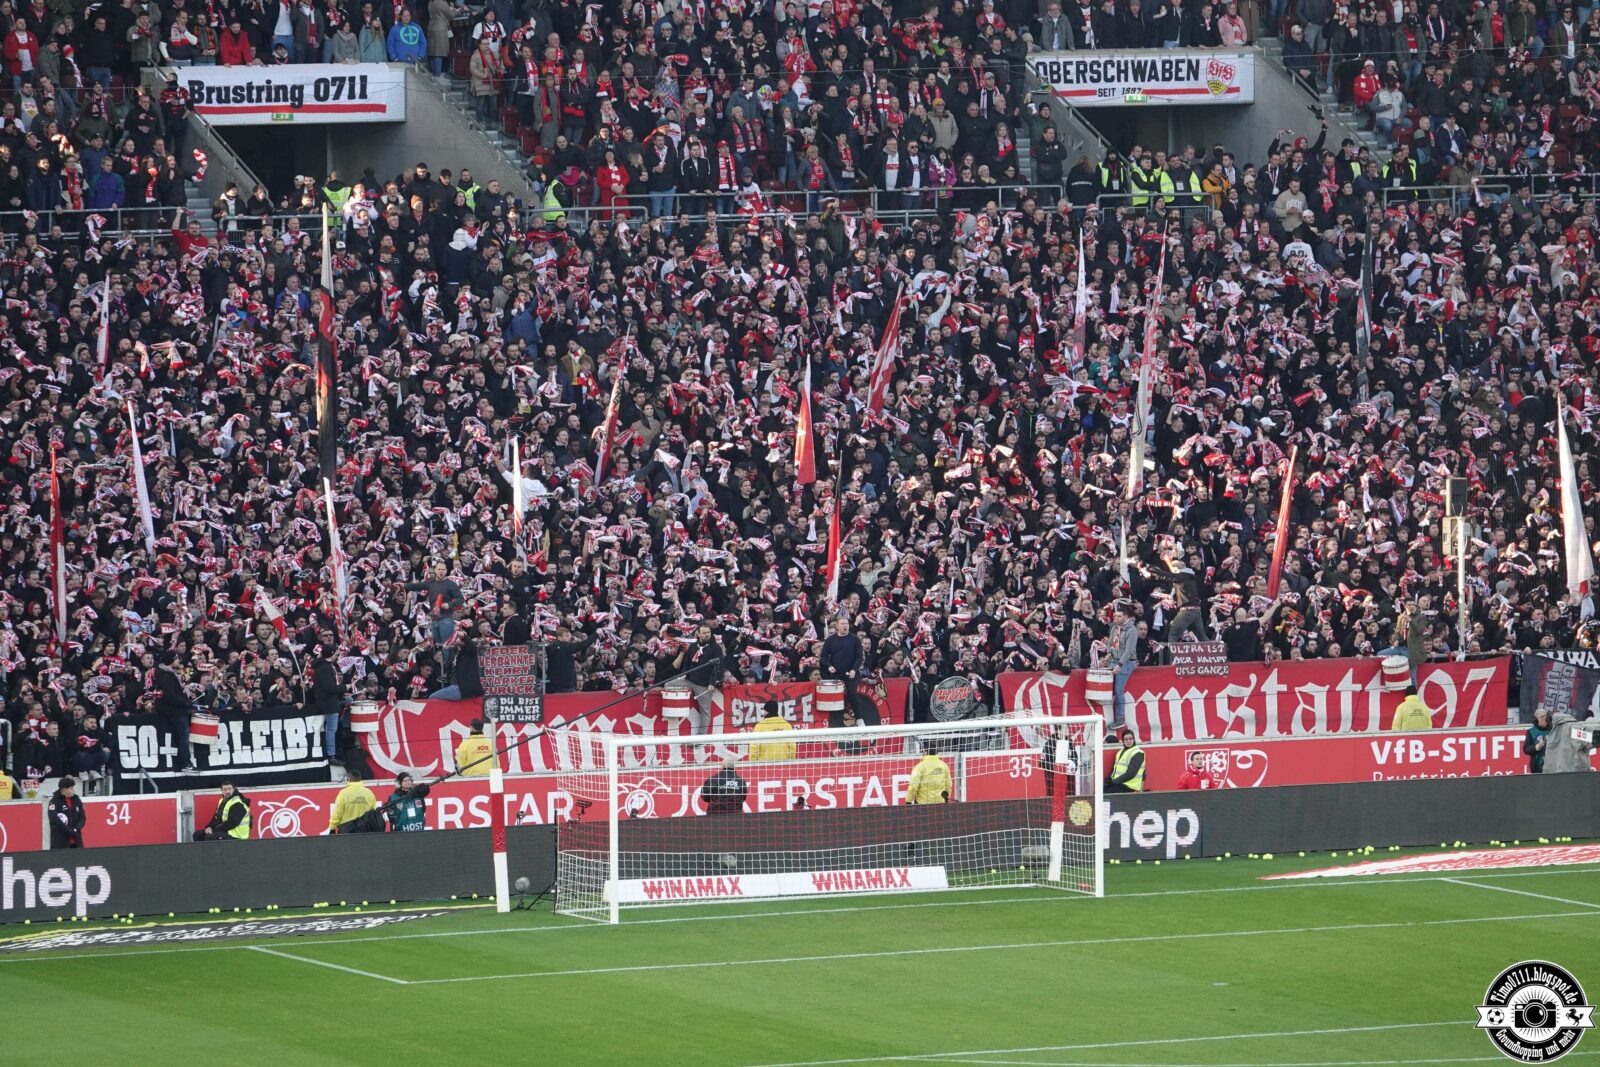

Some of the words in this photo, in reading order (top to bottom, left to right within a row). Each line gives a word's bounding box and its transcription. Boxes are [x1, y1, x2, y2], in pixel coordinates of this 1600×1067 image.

[1035, 58, 1200, 84] OBERSCHWABEN
[187, 79, 304, 109] Brustring
[313, 75, 368, 101] 0711
[1097, 87, 1116, 97] SEIT
[485, 646, 529, 656] JEDER
[1169, 644, 1204, 654] ULTRA
[1207, 643, 1225, 653] IST
[478, 654, 535, 667] VERBANNTE
[1172, 656, 1193, 665] DER
[1196, 656, 1228, 664] KAMPF
[483, 666, 530, 676] KEHRT
[1175, 666, 1196, 675] UMS
[1197, 665, 1230, 676] GANZE
[500, 697, 514, 705] DU
[518, 697, 540, 705] BIST
[1416, 665, 1496, 729] 97
[499, 705, 540, 714] IMMER
[518, 713, 541, 721] UNS!
[207, 715, 325, 767] BLEIBT
[1370, 735, 1528, 765] VfB-STIFT
[1009, 756, 1033, 778] 35
[106, 803, 131, 826] 34
[402, 821, 423, 832] HOST
[1102, 801, 1200, 860] hep
[2, 856, 112, 917] hep
[642, 876, 743, 900] WINAMAX
[811, 868, 912, 892] WINAMAX
